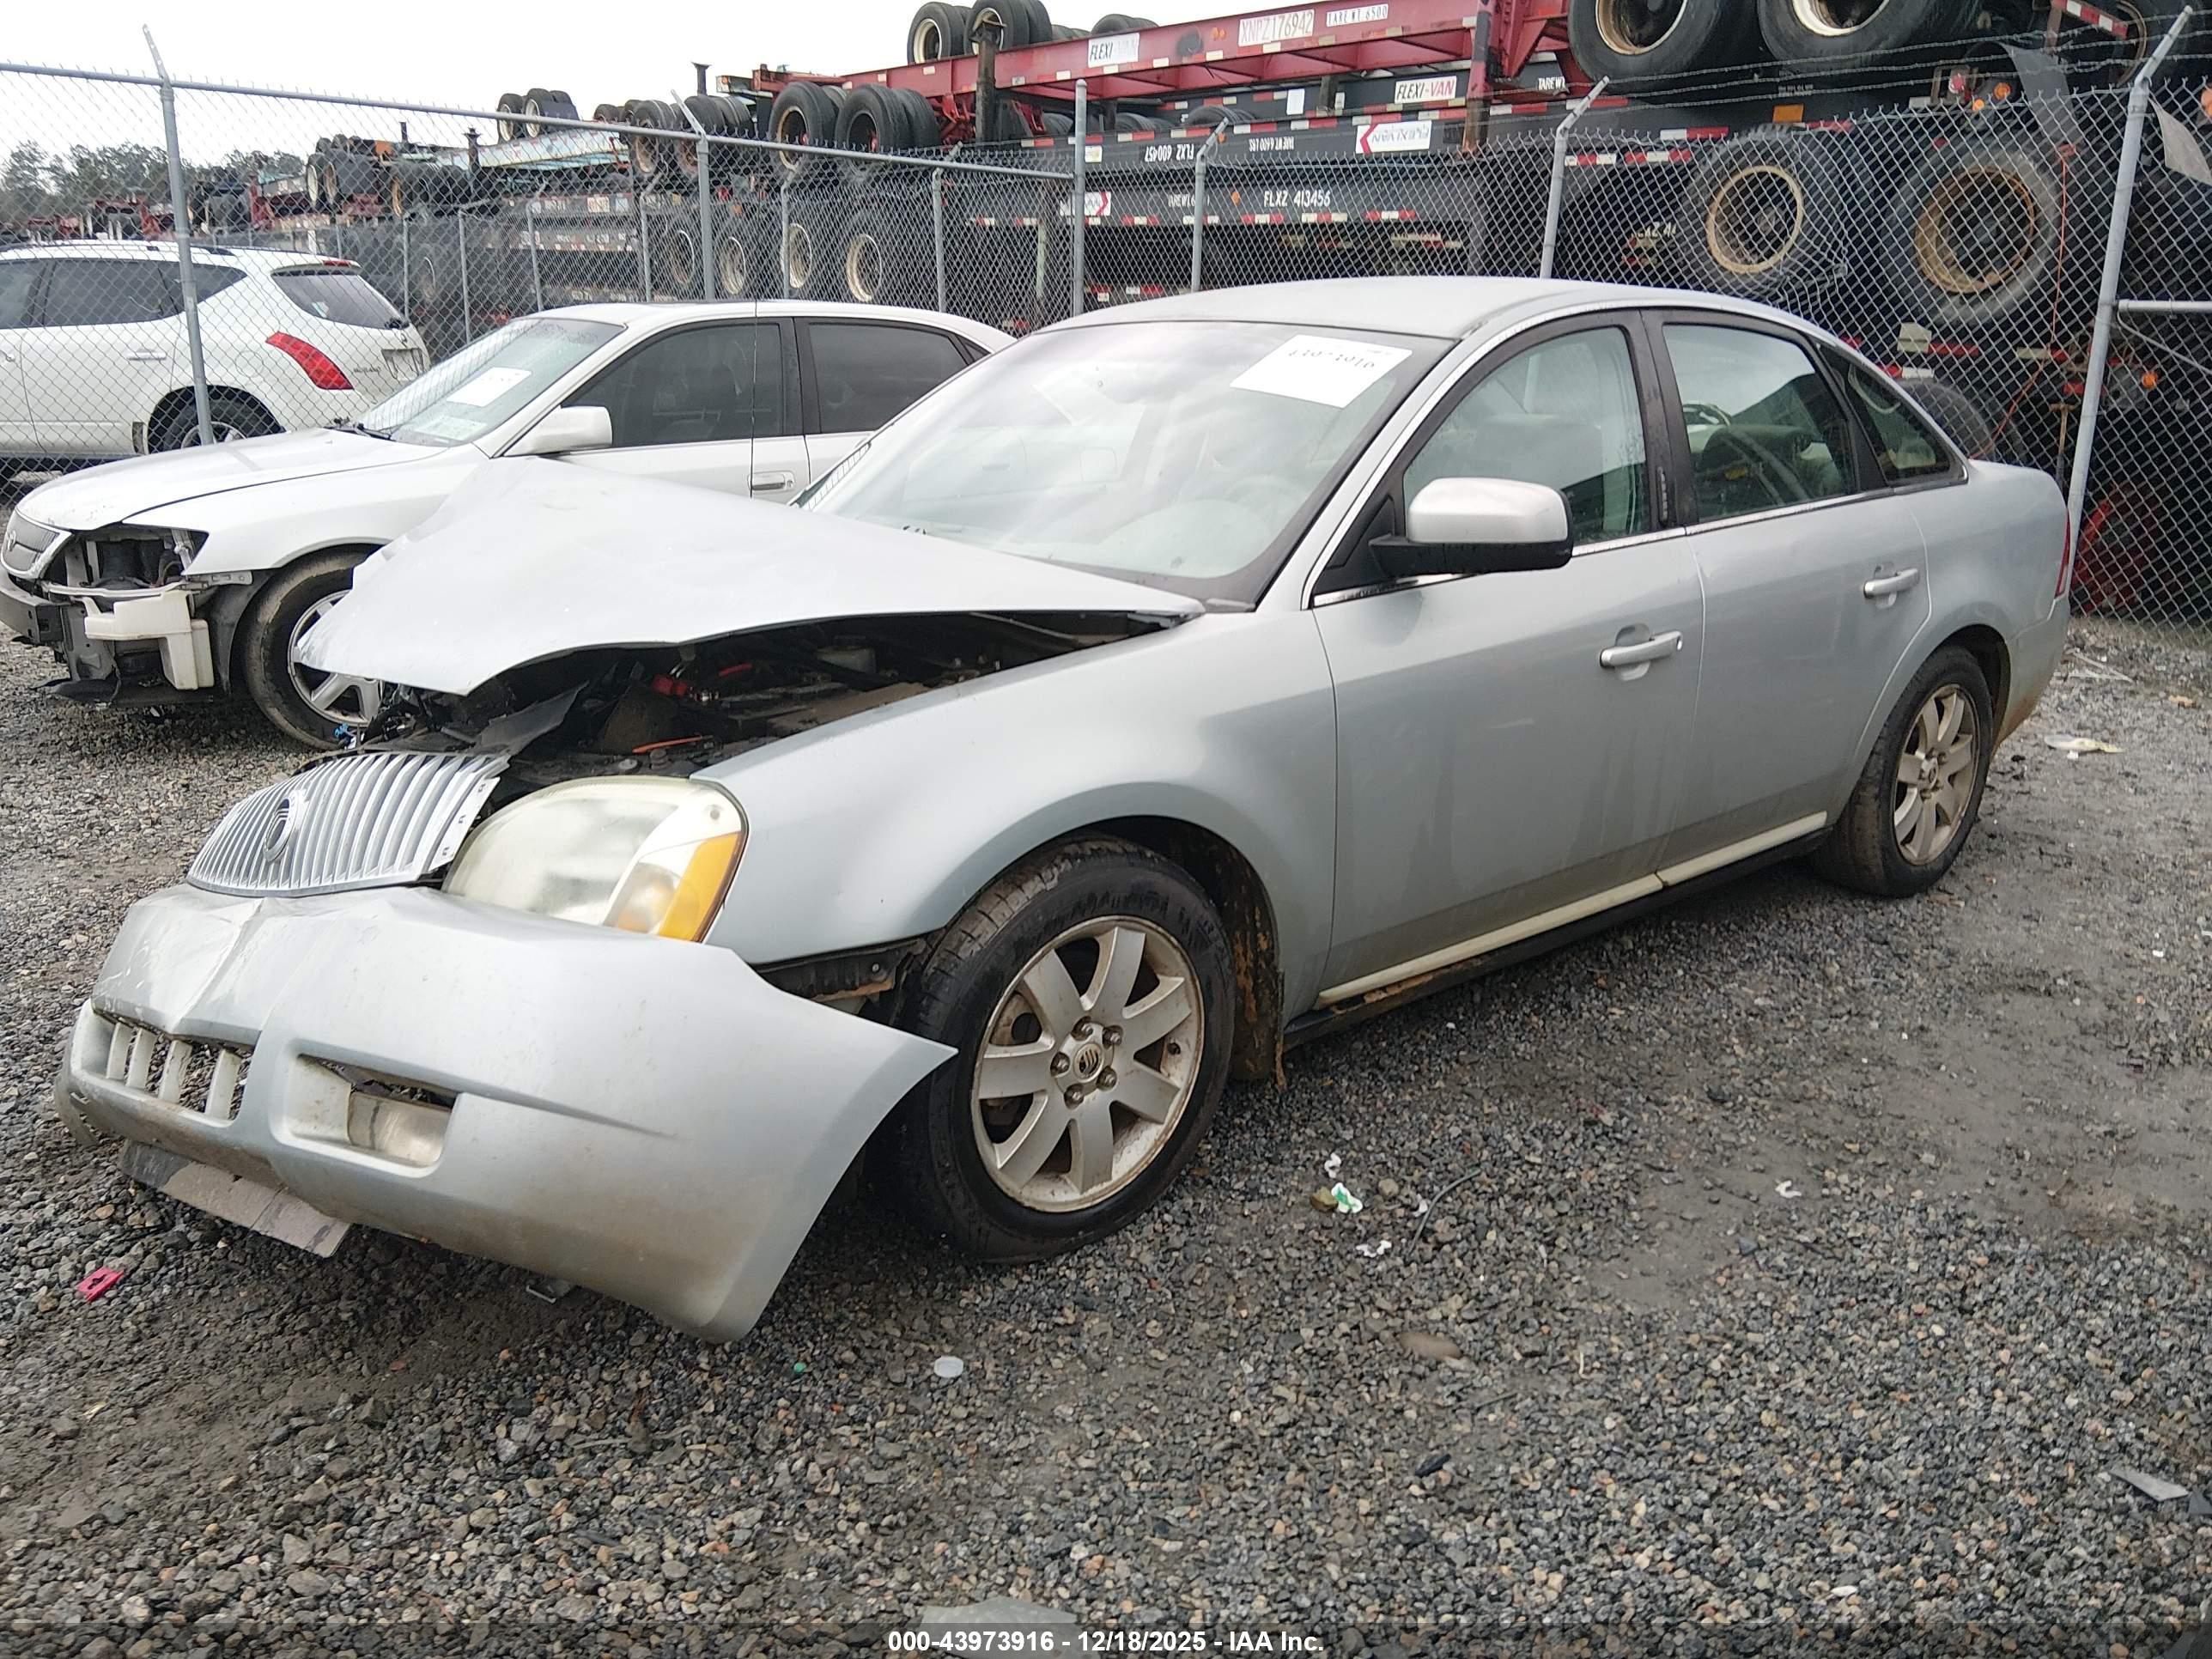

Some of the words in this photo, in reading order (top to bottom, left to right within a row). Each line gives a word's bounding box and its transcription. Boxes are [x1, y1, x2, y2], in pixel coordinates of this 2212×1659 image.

[1365, 5, 1388, 20] 6500
[1241, 10, 1314, 44] XNPZ176942
[1396, 78, 1455, 100] FLEXI-VAN
[1263, 190, 1289, 208] FLXZ
[1293, 190, 1331, 208] 413456
